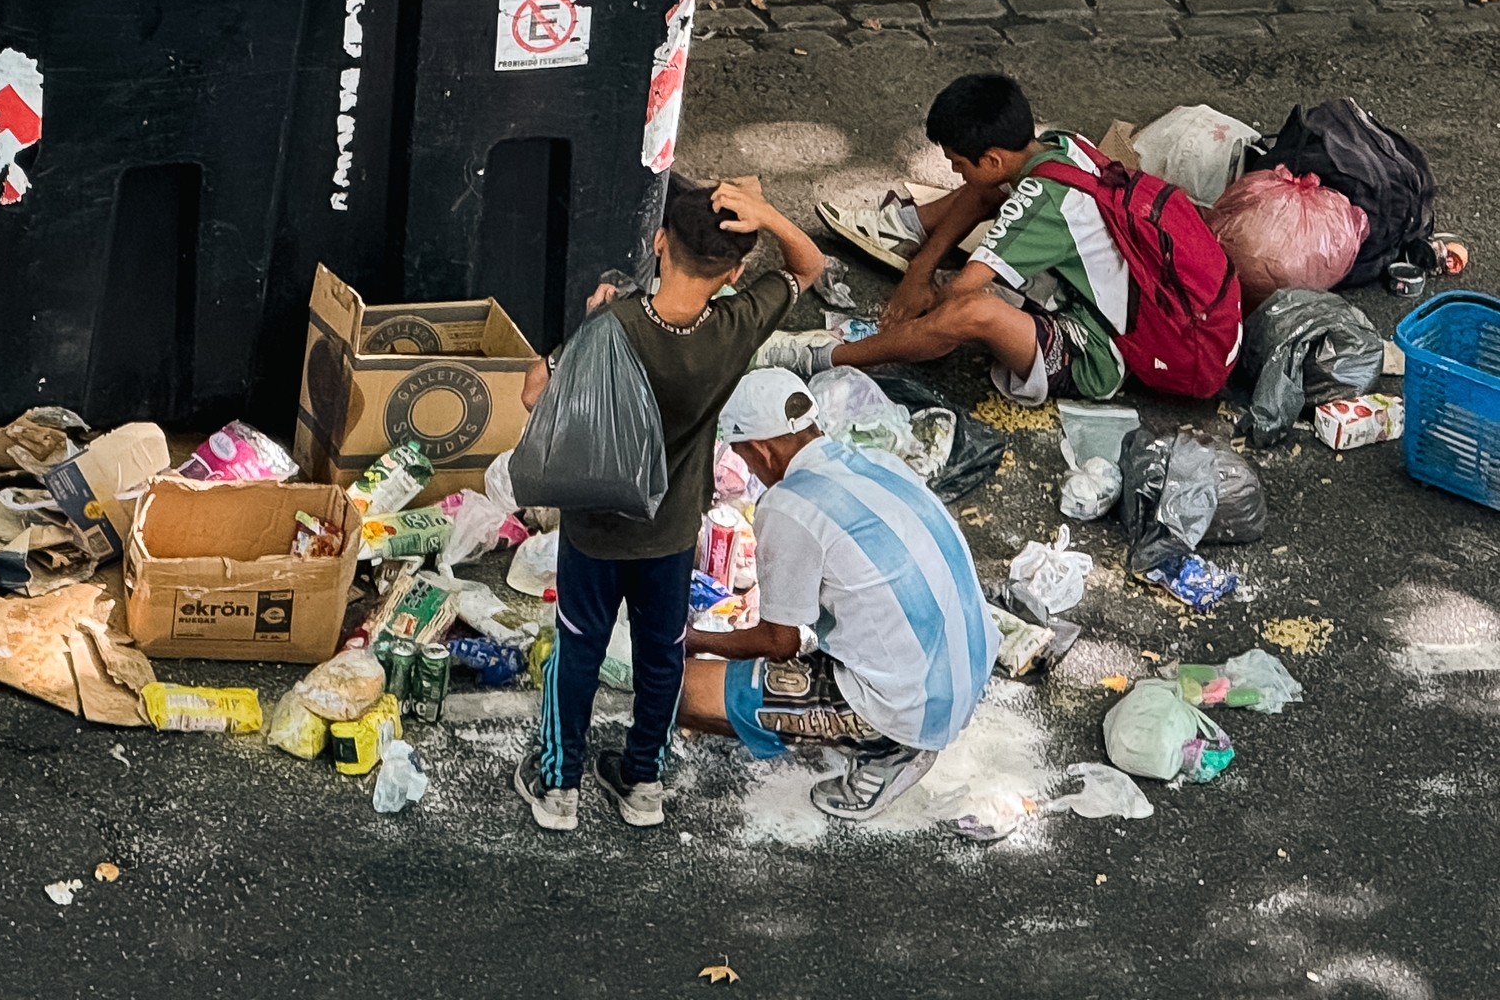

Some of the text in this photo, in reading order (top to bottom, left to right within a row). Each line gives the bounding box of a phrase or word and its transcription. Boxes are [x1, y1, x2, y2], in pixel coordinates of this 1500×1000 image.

[529, 4, 560, 41] E
[497, 59, 538, 68] PROHIBIDO
[397, 370, 484, 403] GALLETITAS
[393, 420, 479, 454] SUTIDAS
[180, 600, 249, 617] ekrön
